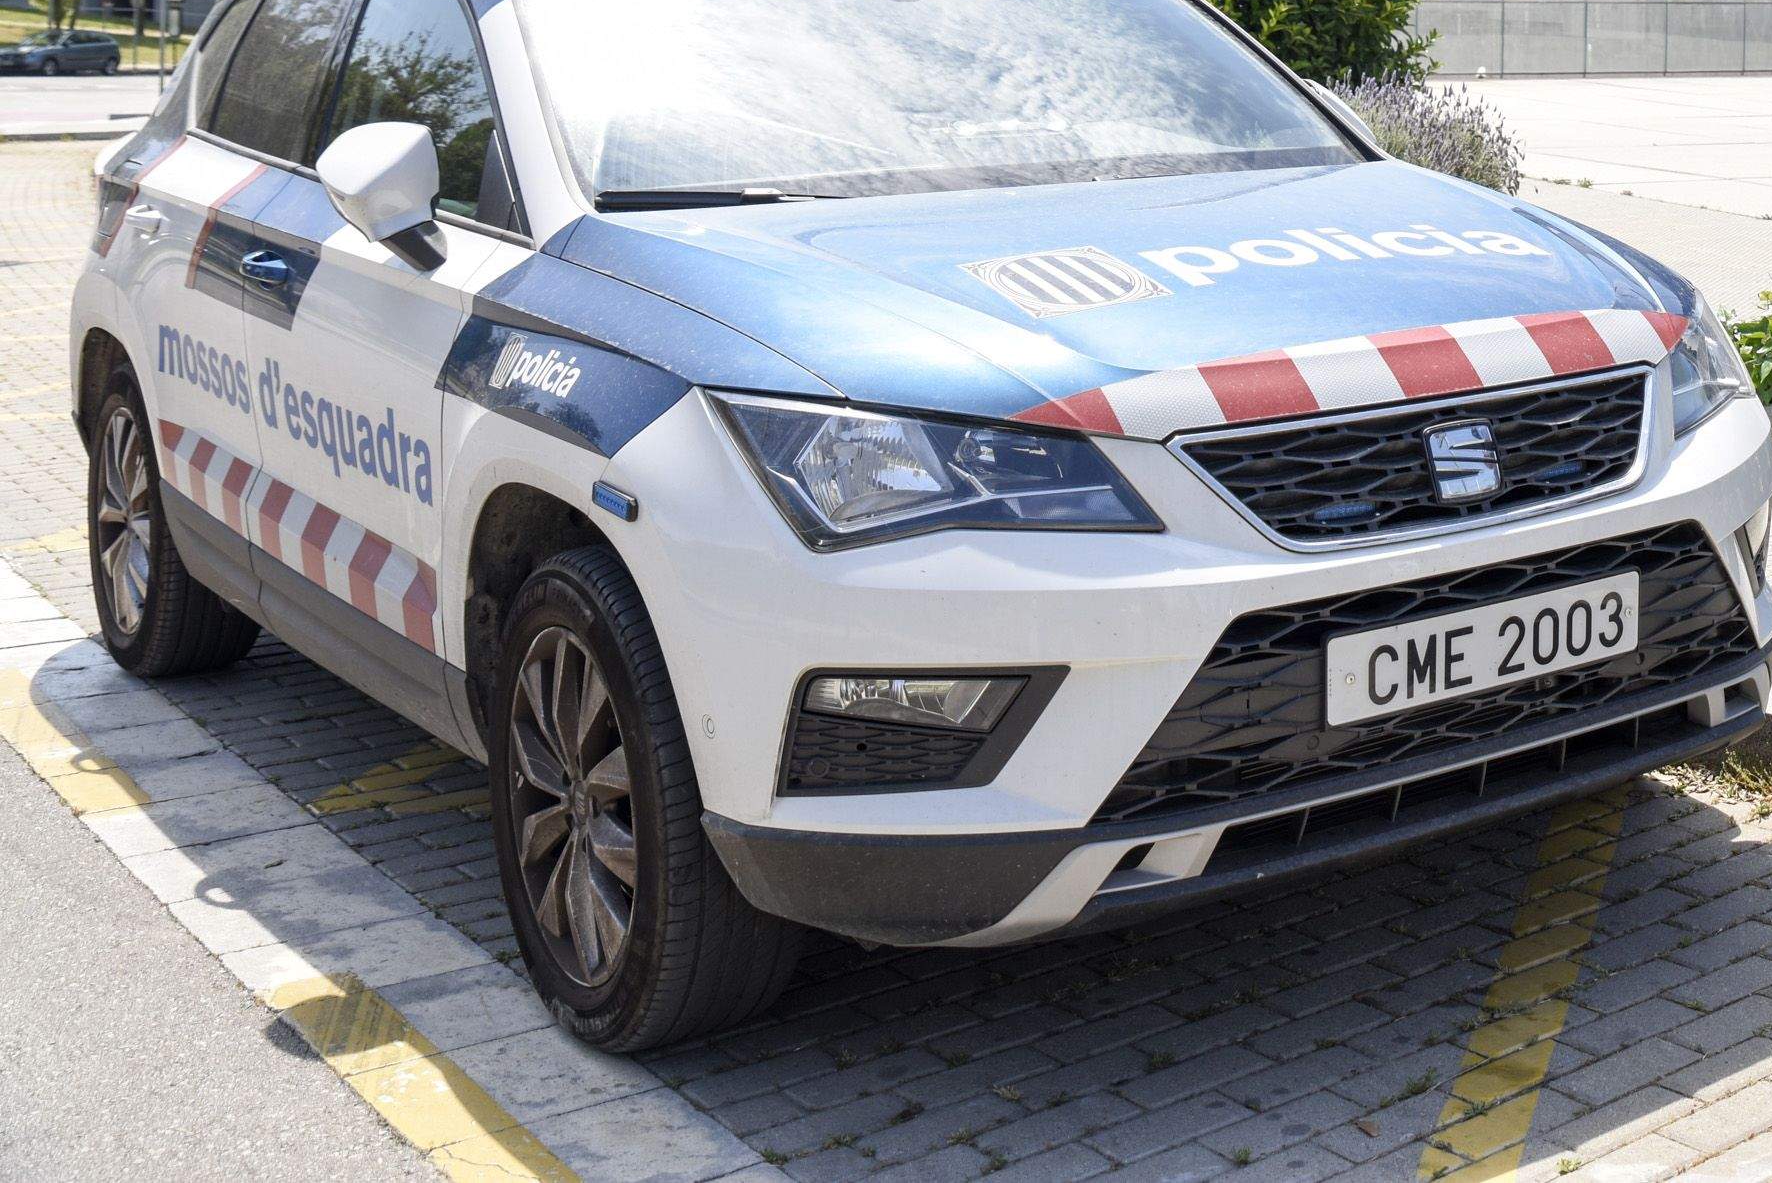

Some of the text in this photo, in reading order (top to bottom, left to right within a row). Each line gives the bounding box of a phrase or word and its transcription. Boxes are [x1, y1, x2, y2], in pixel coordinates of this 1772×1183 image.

[1138, 224, 1551, 286] policia
[158, 323, 434, 507] mossos d'esquadra
[505, 349, 581, 398] policia
[1367, 591, 1625, 706] CME 2003
